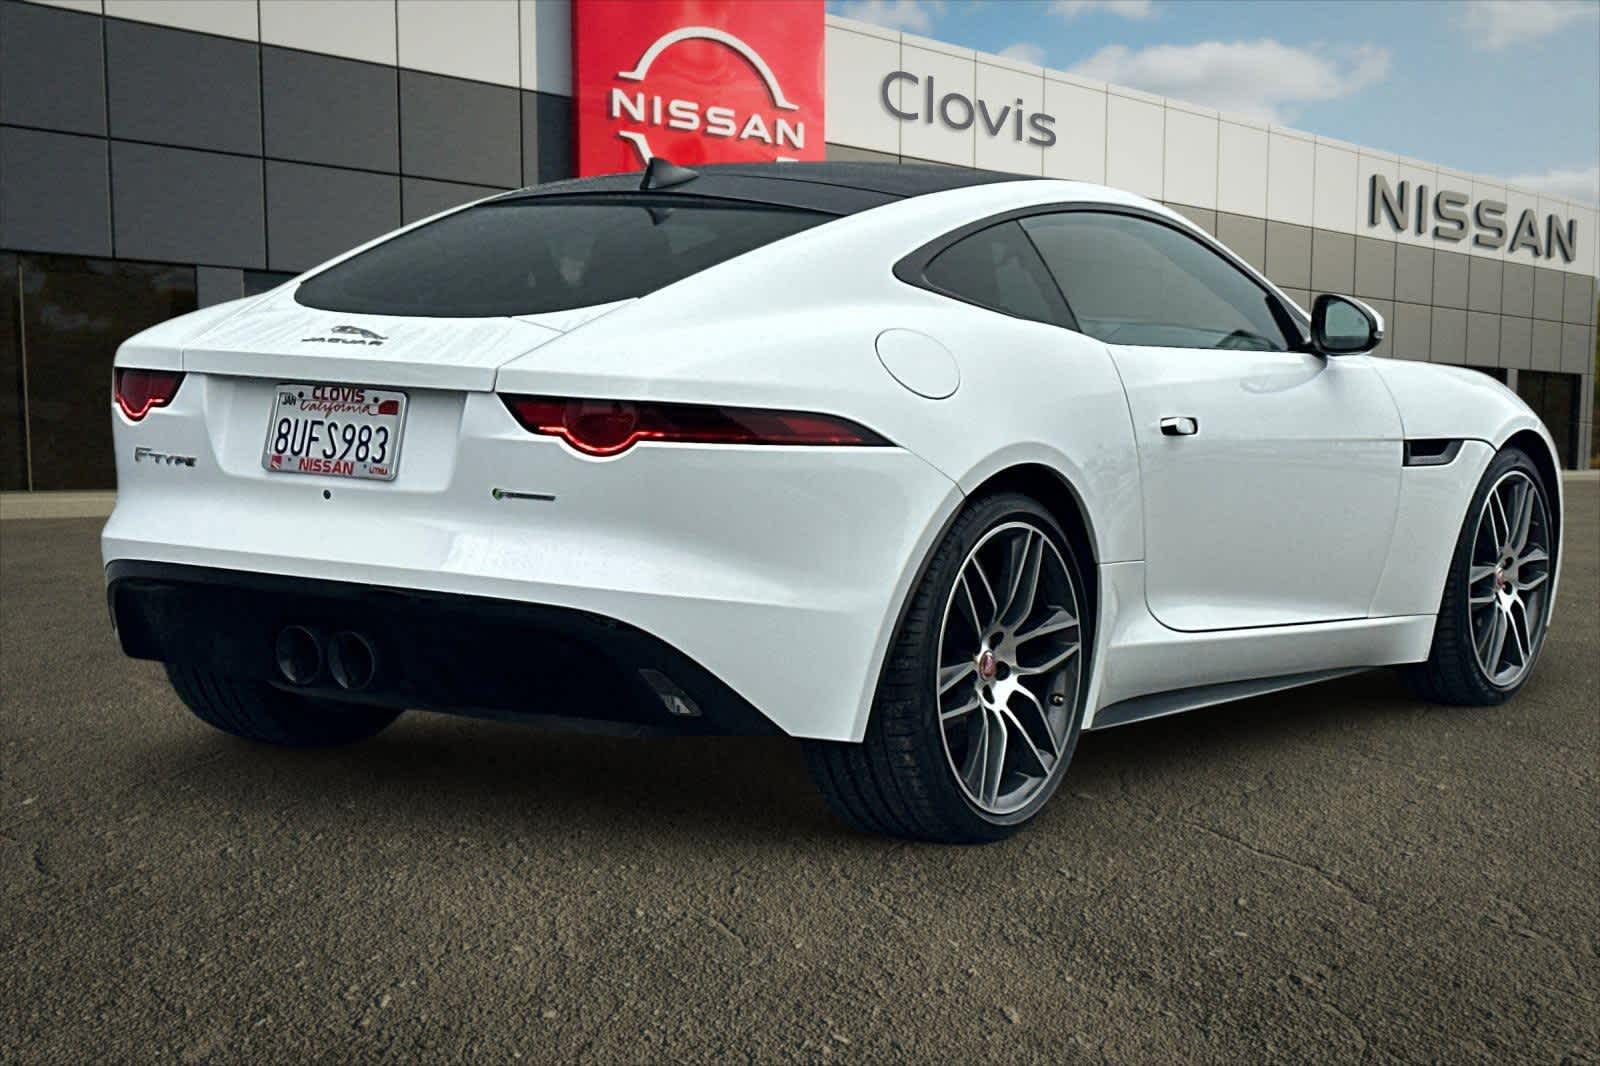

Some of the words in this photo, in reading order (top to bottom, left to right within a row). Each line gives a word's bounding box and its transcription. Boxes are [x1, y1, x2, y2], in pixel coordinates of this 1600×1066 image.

[611, 87, 805, 148] NISSAN
[882, 70, 1057, 147] Clovis
[1368, 173, 1577, 263] NISSAN
[300, 400, 378, 418] California
[312, 386, 365, 404] CLOVIS
[274, 417, 389, 464] 8UFS983
[299, 457, 355, 476] NISSAN
